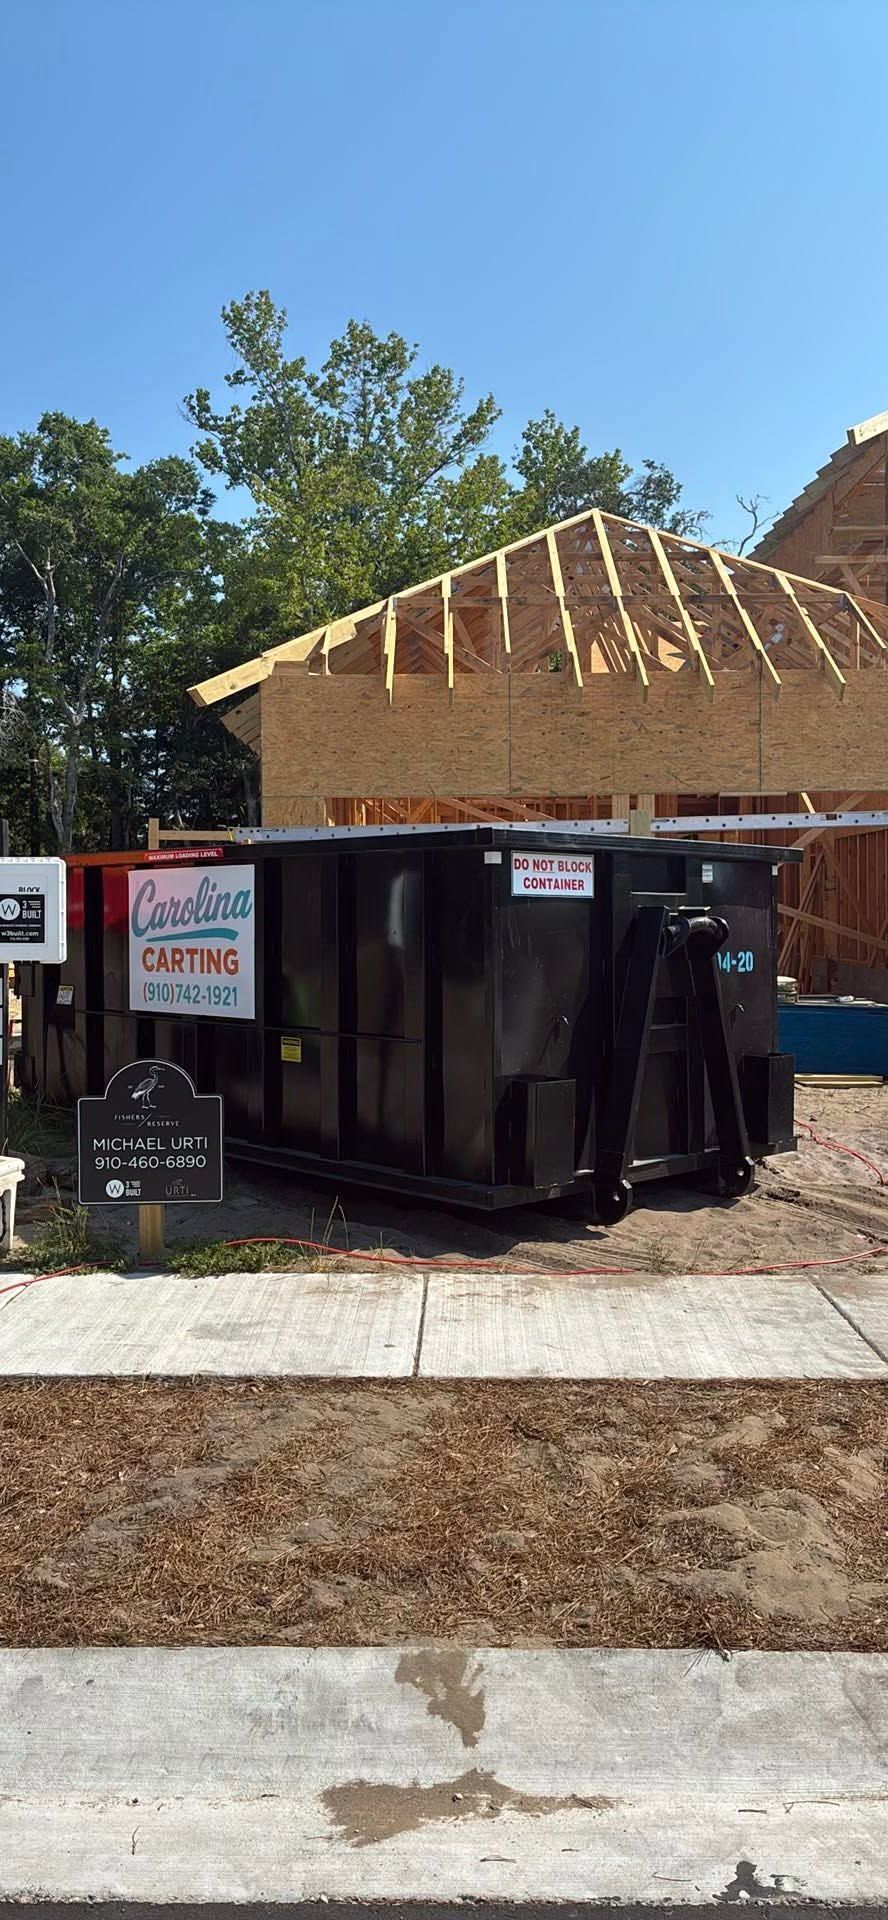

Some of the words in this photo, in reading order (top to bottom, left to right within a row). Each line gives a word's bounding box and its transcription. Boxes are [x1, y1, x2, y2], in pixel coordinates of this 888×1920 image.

[514, 858, 529, 870] DO
[533, 859, 555, 871] NOT
[558, 860, 592, 873] BLOCK
[523, 877, 584, 890] CONTAINER
[131, 876, 252, 938] Carolina
[22, 910, 42, 919] BUILT
[142, 947, 239, 975] CARTING
[143, 982, 238, 1006] (910)742-1921
[93, 1138, 166, 1151] MICHAEL
[171, 1137, 208, 1150] URTI
[95, 1155, 206, 1169] 910-460-6890
[165, 1186, 189, 1195] URTI
